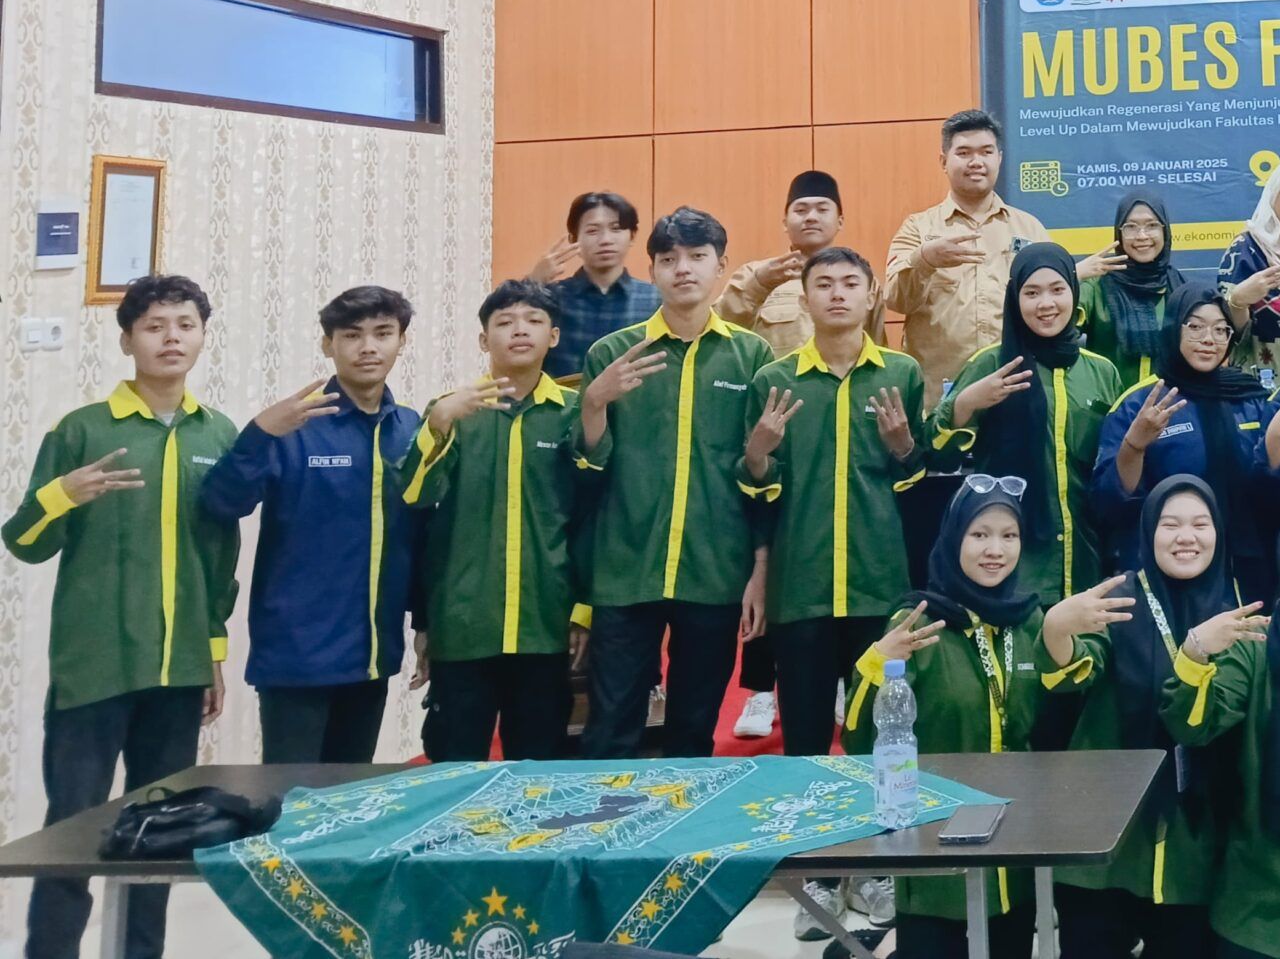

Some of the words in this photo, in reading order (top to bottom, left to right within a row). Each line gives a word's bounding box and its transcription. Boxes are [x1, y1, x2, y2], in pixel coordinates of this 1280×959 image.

[1022, 21, 1239, 98] MUBES
[1019, 106, 1104, 120] Mewujudkan
[1107, 101, 1183, 117] Regenerasi
[1186, 100, 1221, 114] Yang
[1019, 125, 1055, 137] Level
[1058, 124, 1078, 137] Up
[1080, 121, 1123, 134] Dalam
[1126, 118, 1212, 133] Mewujudkan
[1215, 113, 1274, 127] Fakultas
[1077, 163, 1121, 174] KAMIS,
[1123, 162, 1139, 172] 09
[1141, 160, 1194, 171] JANUARI
[1196, 158, 1228, 169] 2025
[1077, 176, 1117, 188] 07.00
[1120, 175, 1146, 186] WIB
[1157, 172, 1217, 185] SELESAI
